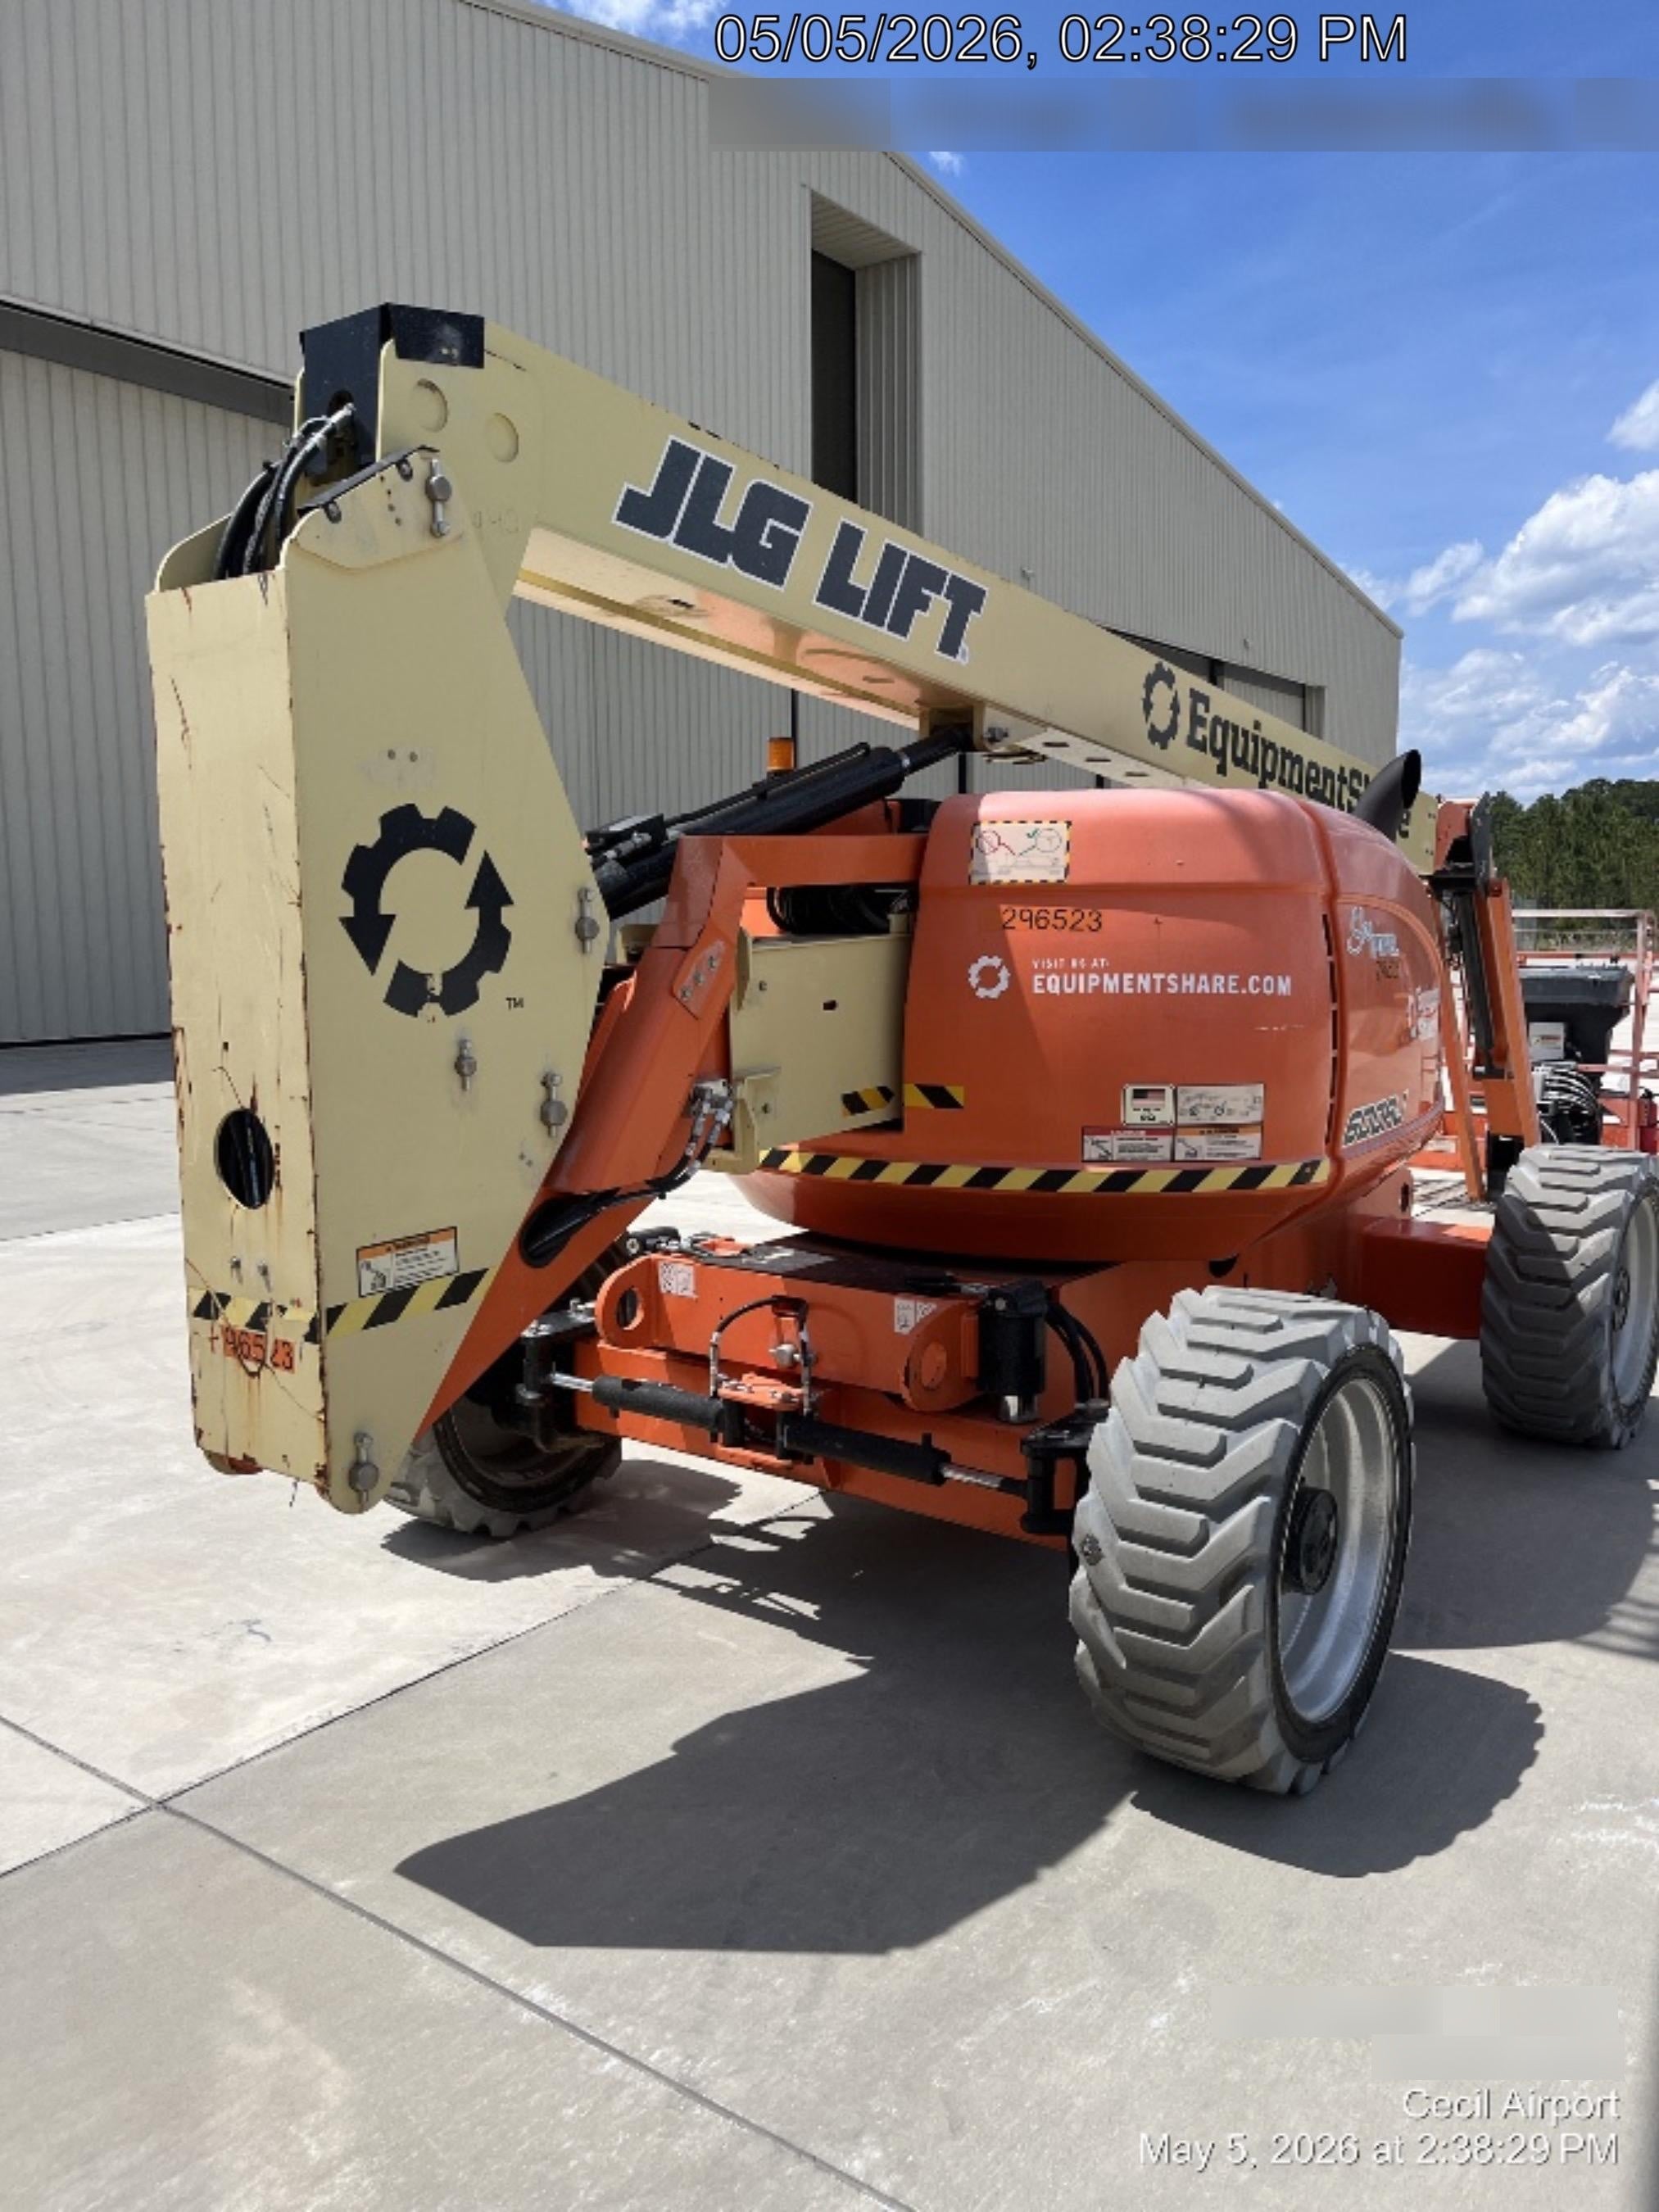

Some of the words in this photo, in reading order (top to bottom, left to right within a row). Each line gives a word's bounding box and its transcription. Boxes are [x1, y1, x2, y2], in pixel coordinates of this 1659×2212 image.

[611, 434, 814, 592] JLG
[811, 517, 989, 662] LIFT
[1002, 907, 1102, 932] 296523
[1032, 957, 1065, 970] VISIT
[1033, 972, 1292, 997] EQUIPMENTSHARE.COM
